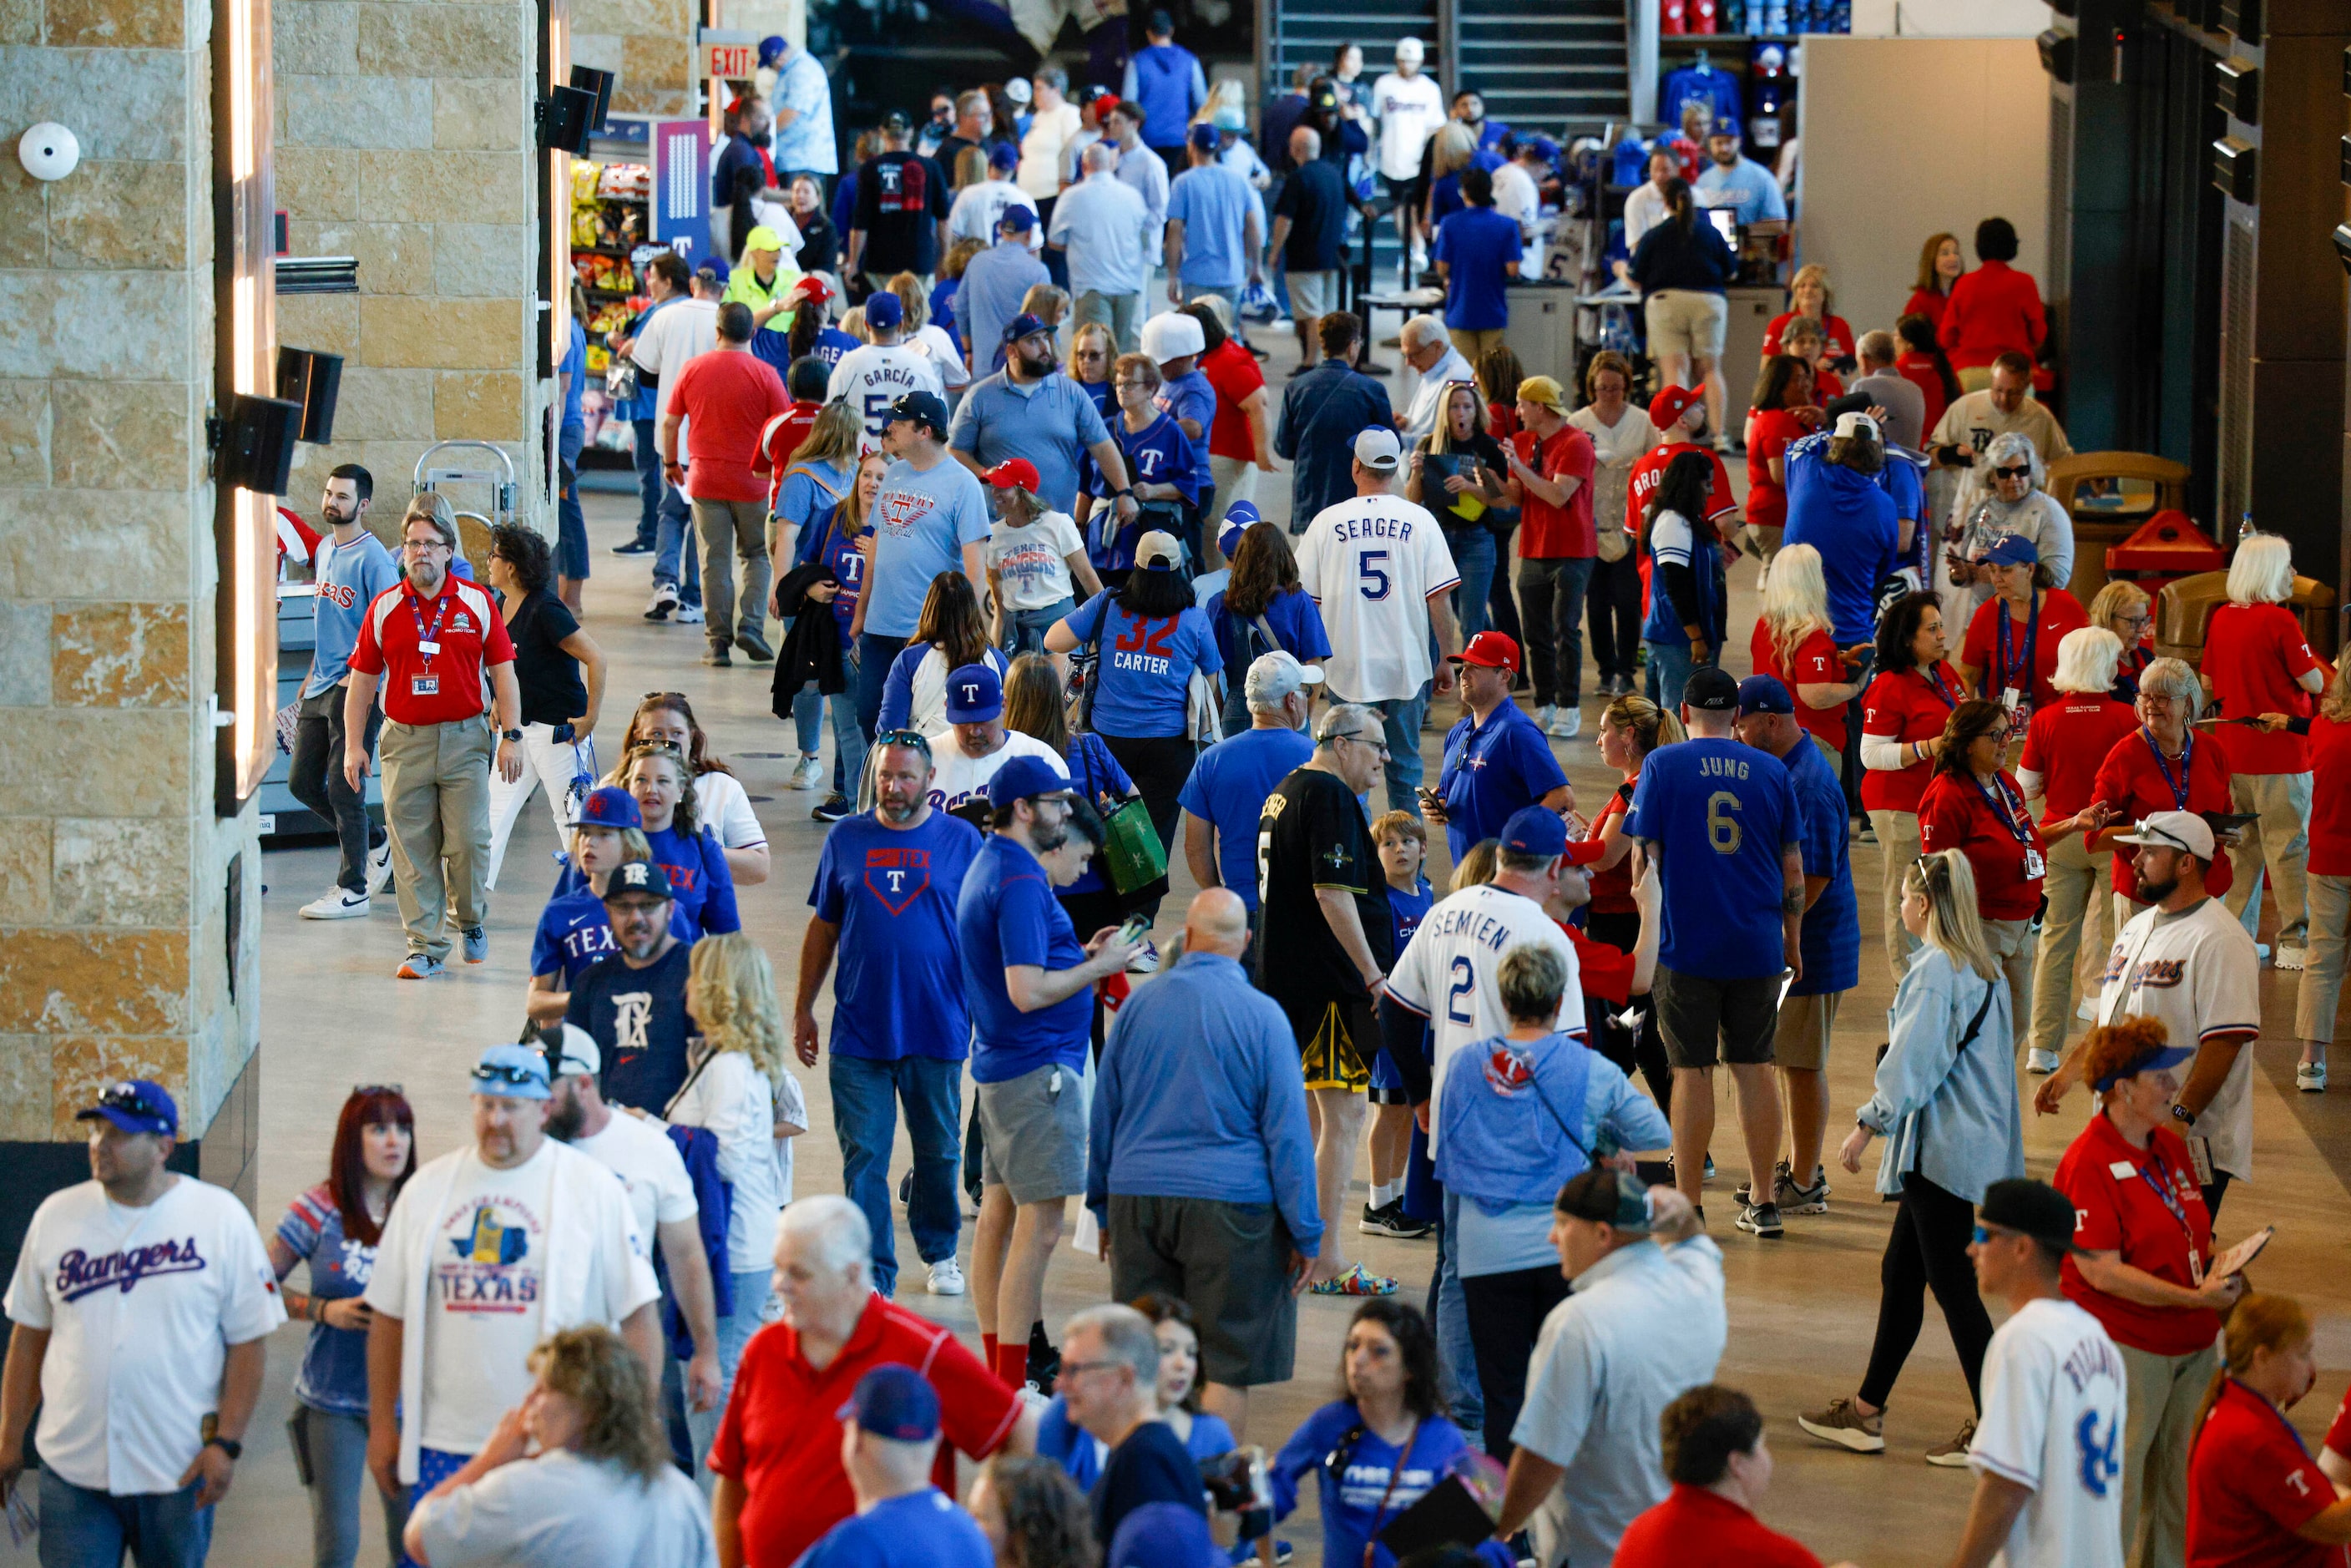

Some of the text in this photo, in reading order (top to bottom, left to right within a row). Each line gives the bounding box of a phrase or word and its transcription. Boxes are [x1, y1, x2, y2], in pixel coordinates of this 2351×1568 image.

[711, 48, 749, 76] EXIT
[864, 368, 916, 388] GARCÍA
[999, 460, 1011, 470] T
[1140, 449, 1165, 478] T
[890, 499, 911, 524] T
[1335, 518, 1413, 544] SEAGER
[1004, 544, 1045, 558] TEXAS
[842, 553, 866, 582] T
[999, 551, 1055, 580] RANGERS
[1359, 550, 1392, 602] 5
[1018, 573, 1034, 594] T
[1115, 609, 1180, 658] 32
[1469, 634, 1483, 650] T
[1115, 651, 1169, 675] CARTER
[1813, 656, 1825, 671] T
[962, 684, 979, 703] T
[1867, 708, 1876, 723] T
[1700, 757, 1750, 781] JUNG
[1706, 791, 1743, 854] 6
[1923, 825, 1934, 841] T
[899, 848, 931, 869] TEX
[887, 871, 906, 893] T
[564, 925, 622, 959] TEX
[1433, 909, 1511, 953] SEMIEN
[1449, 955, 1476, 1027] 2
[56, 1237, 206, 1302] Rangers
[438, 1272, 538, 1302] TEXAS
[2285, 1469, 2310, 1497] T
